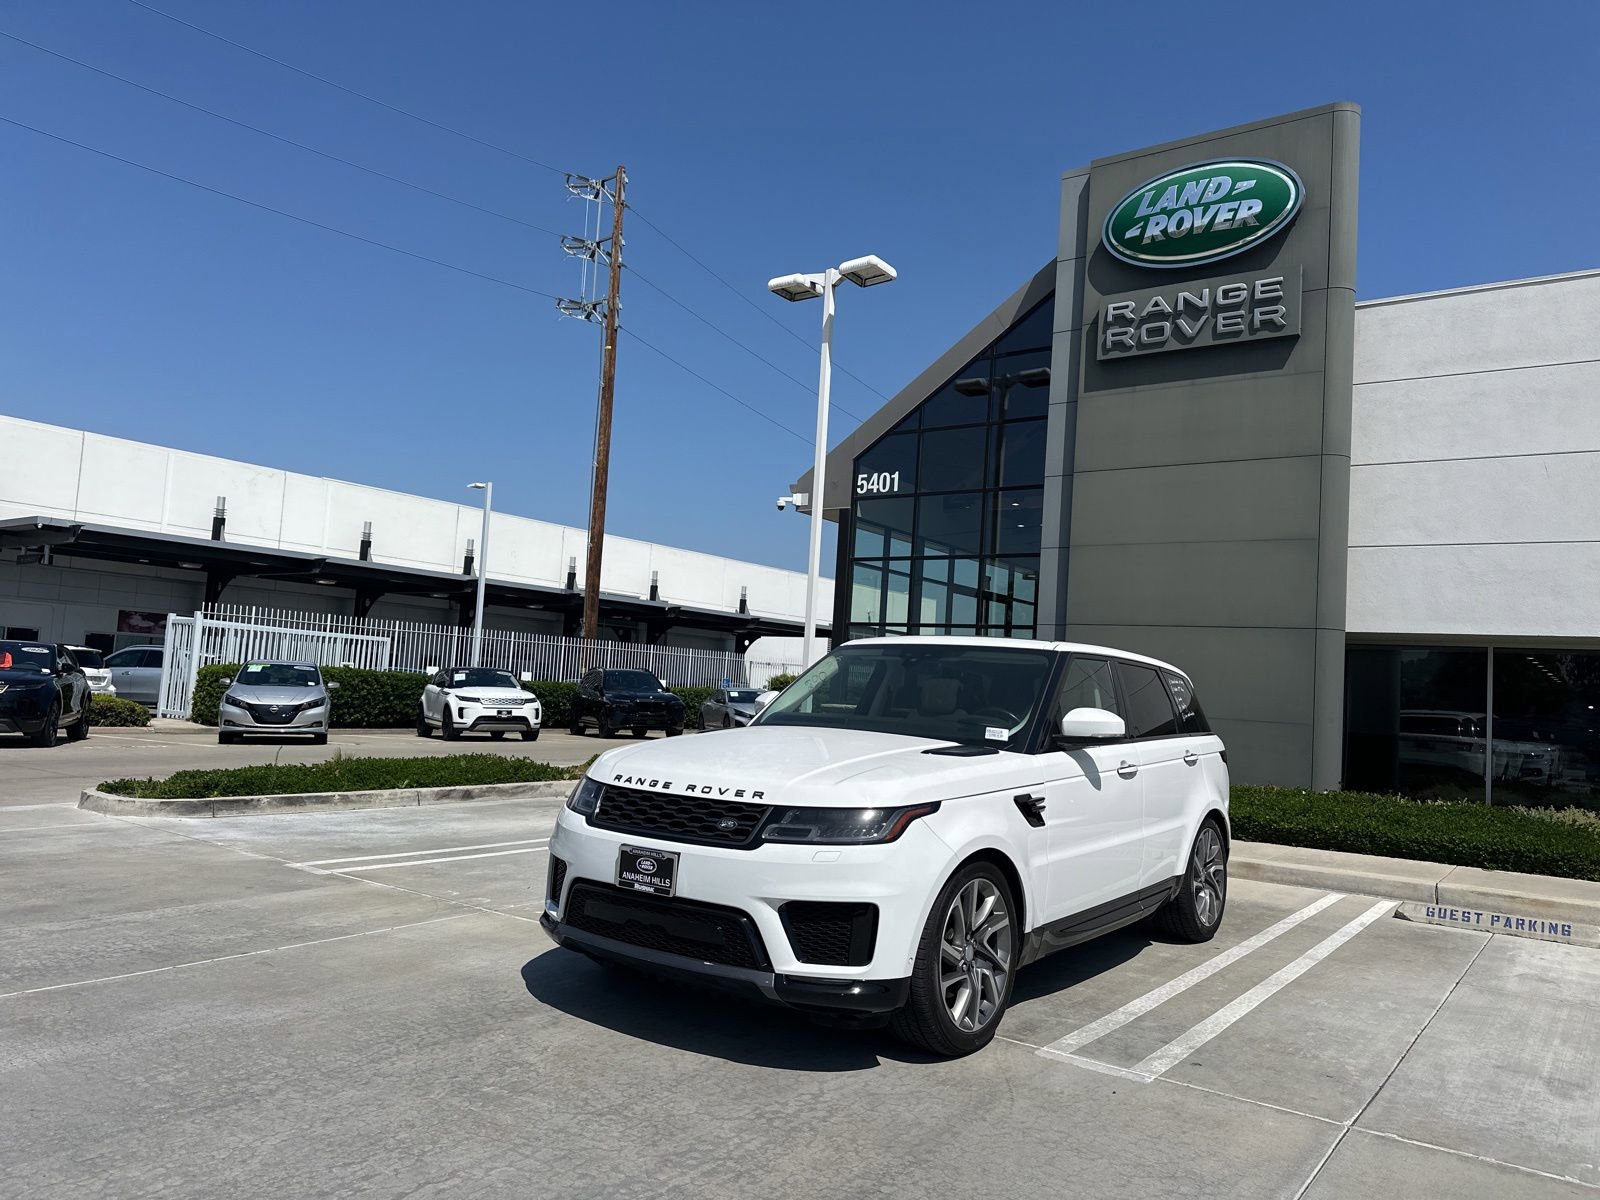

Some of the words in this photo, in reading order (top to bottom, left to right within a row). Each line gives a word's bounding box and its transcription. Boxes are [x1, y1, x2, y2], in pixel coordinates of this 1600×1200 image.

[1134, 176, 1232, 218] LAND
[1142, 198, 1263, 245] ROVER
[1107, 276, 1284, 322] RANGE
[1106, 304, 1287, 349] ROVER
[856, 471, 899, 494] 5401
[613, 774, 673, 790] RANGE
[685, 784, 765, 800] ROVER
[622, 871, 651, 883] ANAHEIM
[651, 876, 671, 887] HILLS
[1426, 906, 1484, 924] GUEST
[1490, 914, 1572, 937] PARKING
